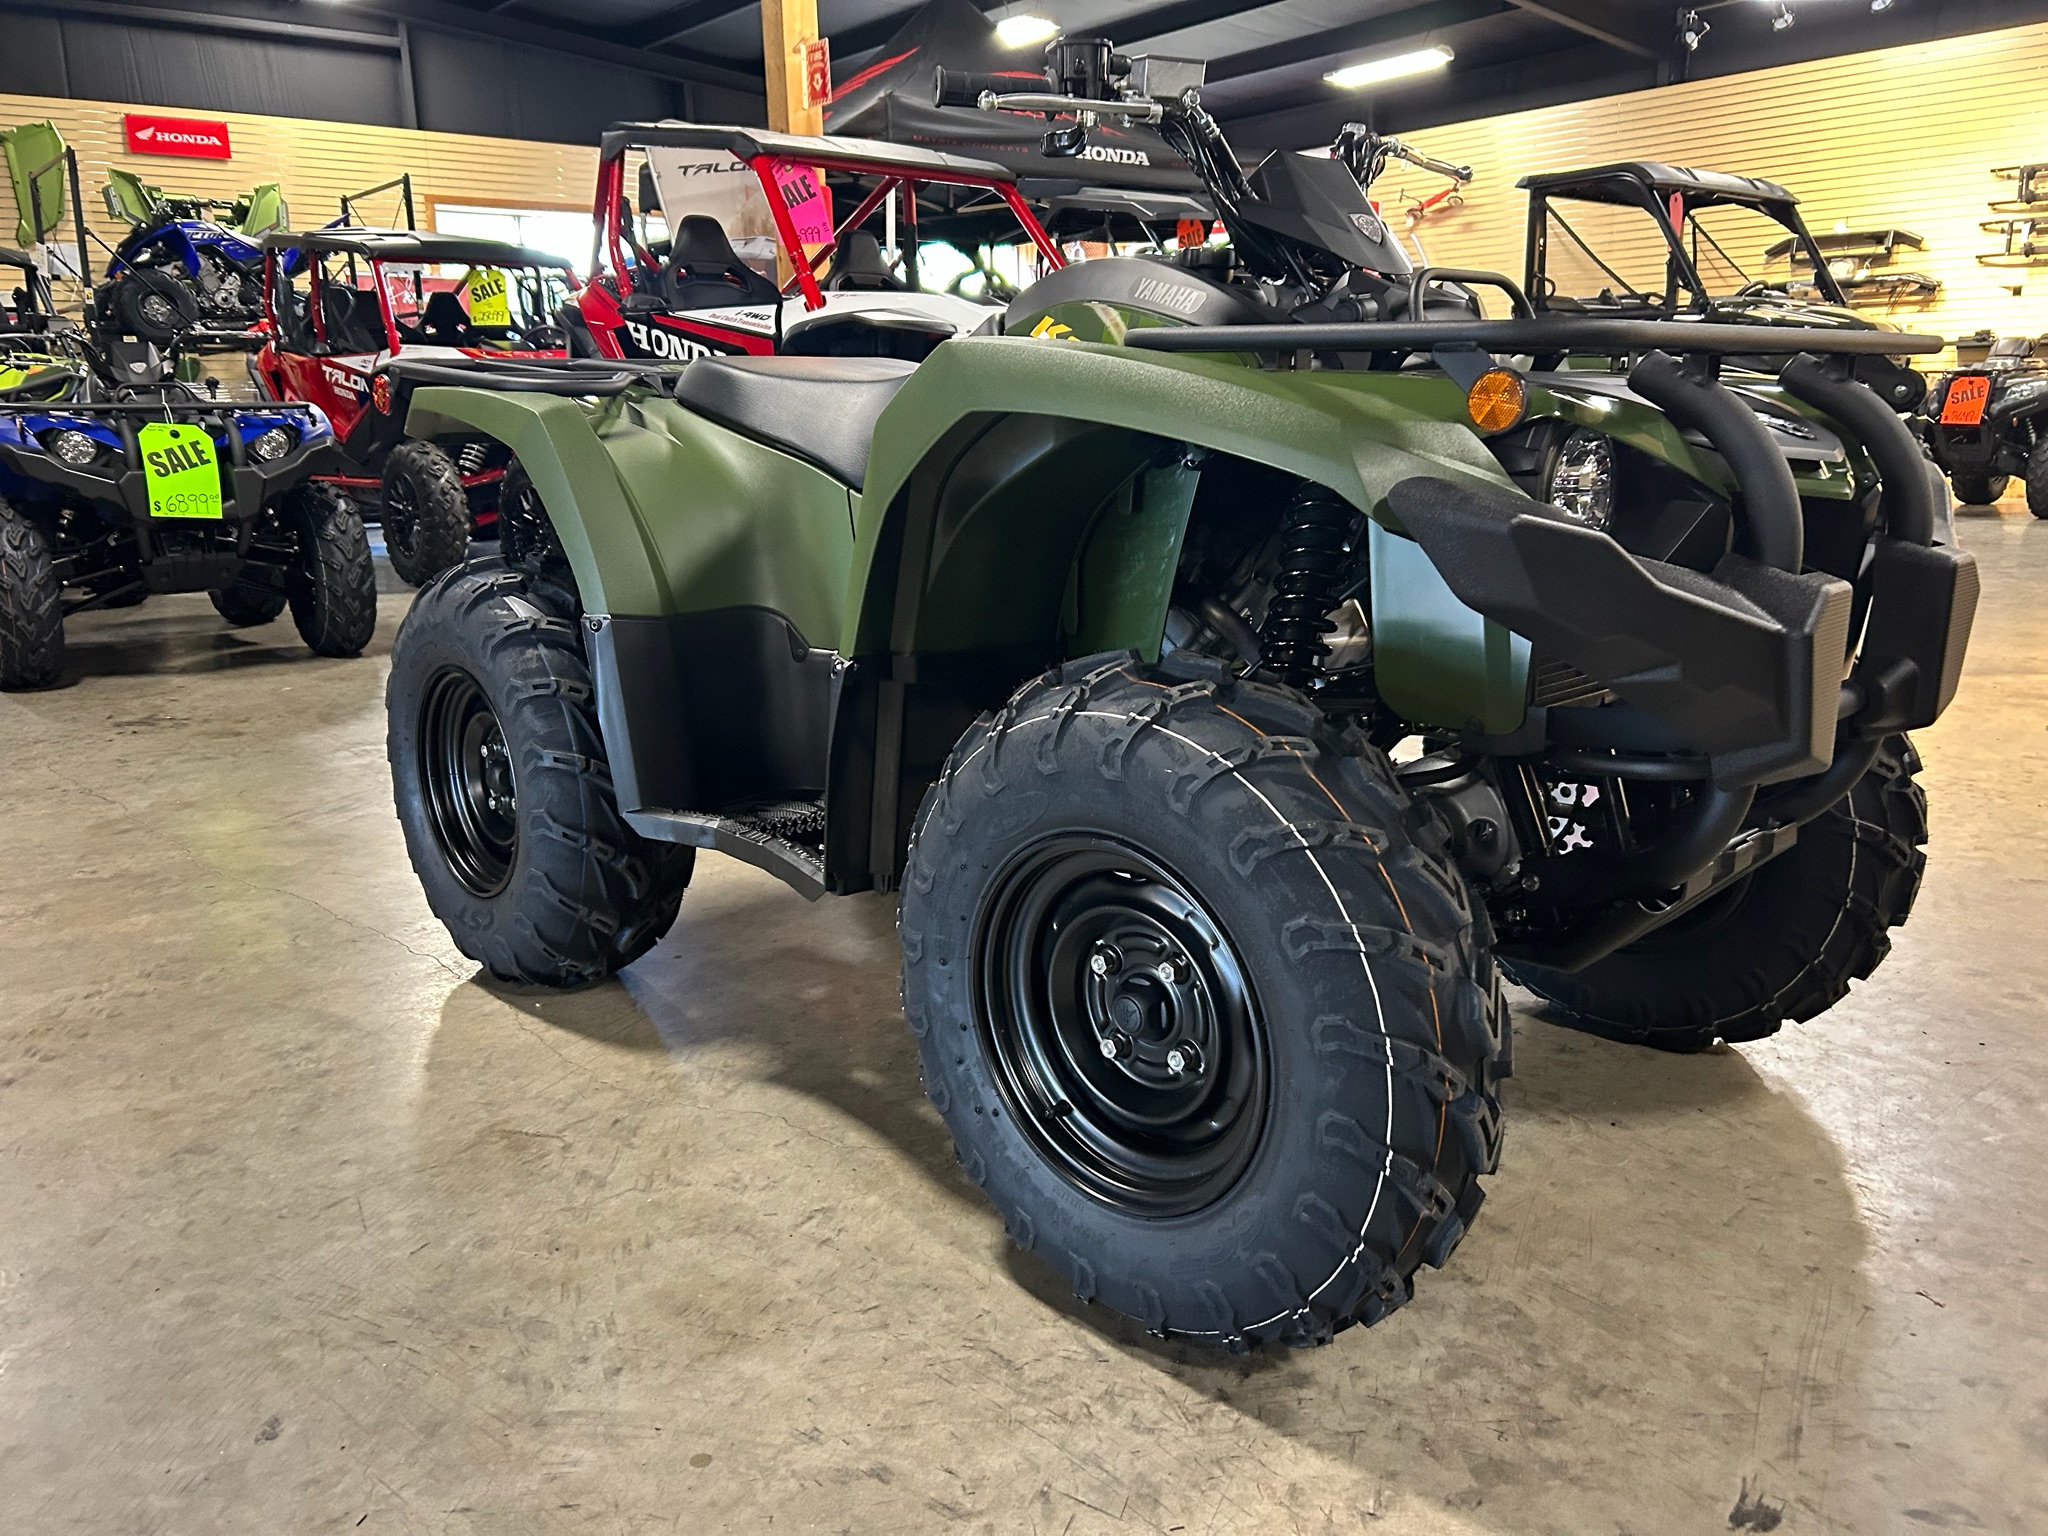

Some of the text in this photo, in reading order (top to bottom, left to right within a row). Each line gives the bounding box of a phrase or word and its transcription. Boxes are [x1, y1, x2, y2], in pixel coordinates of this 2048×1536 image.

[155, 131, 222, 146] HONDA
[677, 161, 754, 176] TALO
[781, 175, 817, 209] ALE
[471, 278, 505, 303] SALE
[1134, 277, 1199, 312] YAMAHA
[1951, 385, 1985, 404] SALE
[147, 440, 211, 477] SALE
